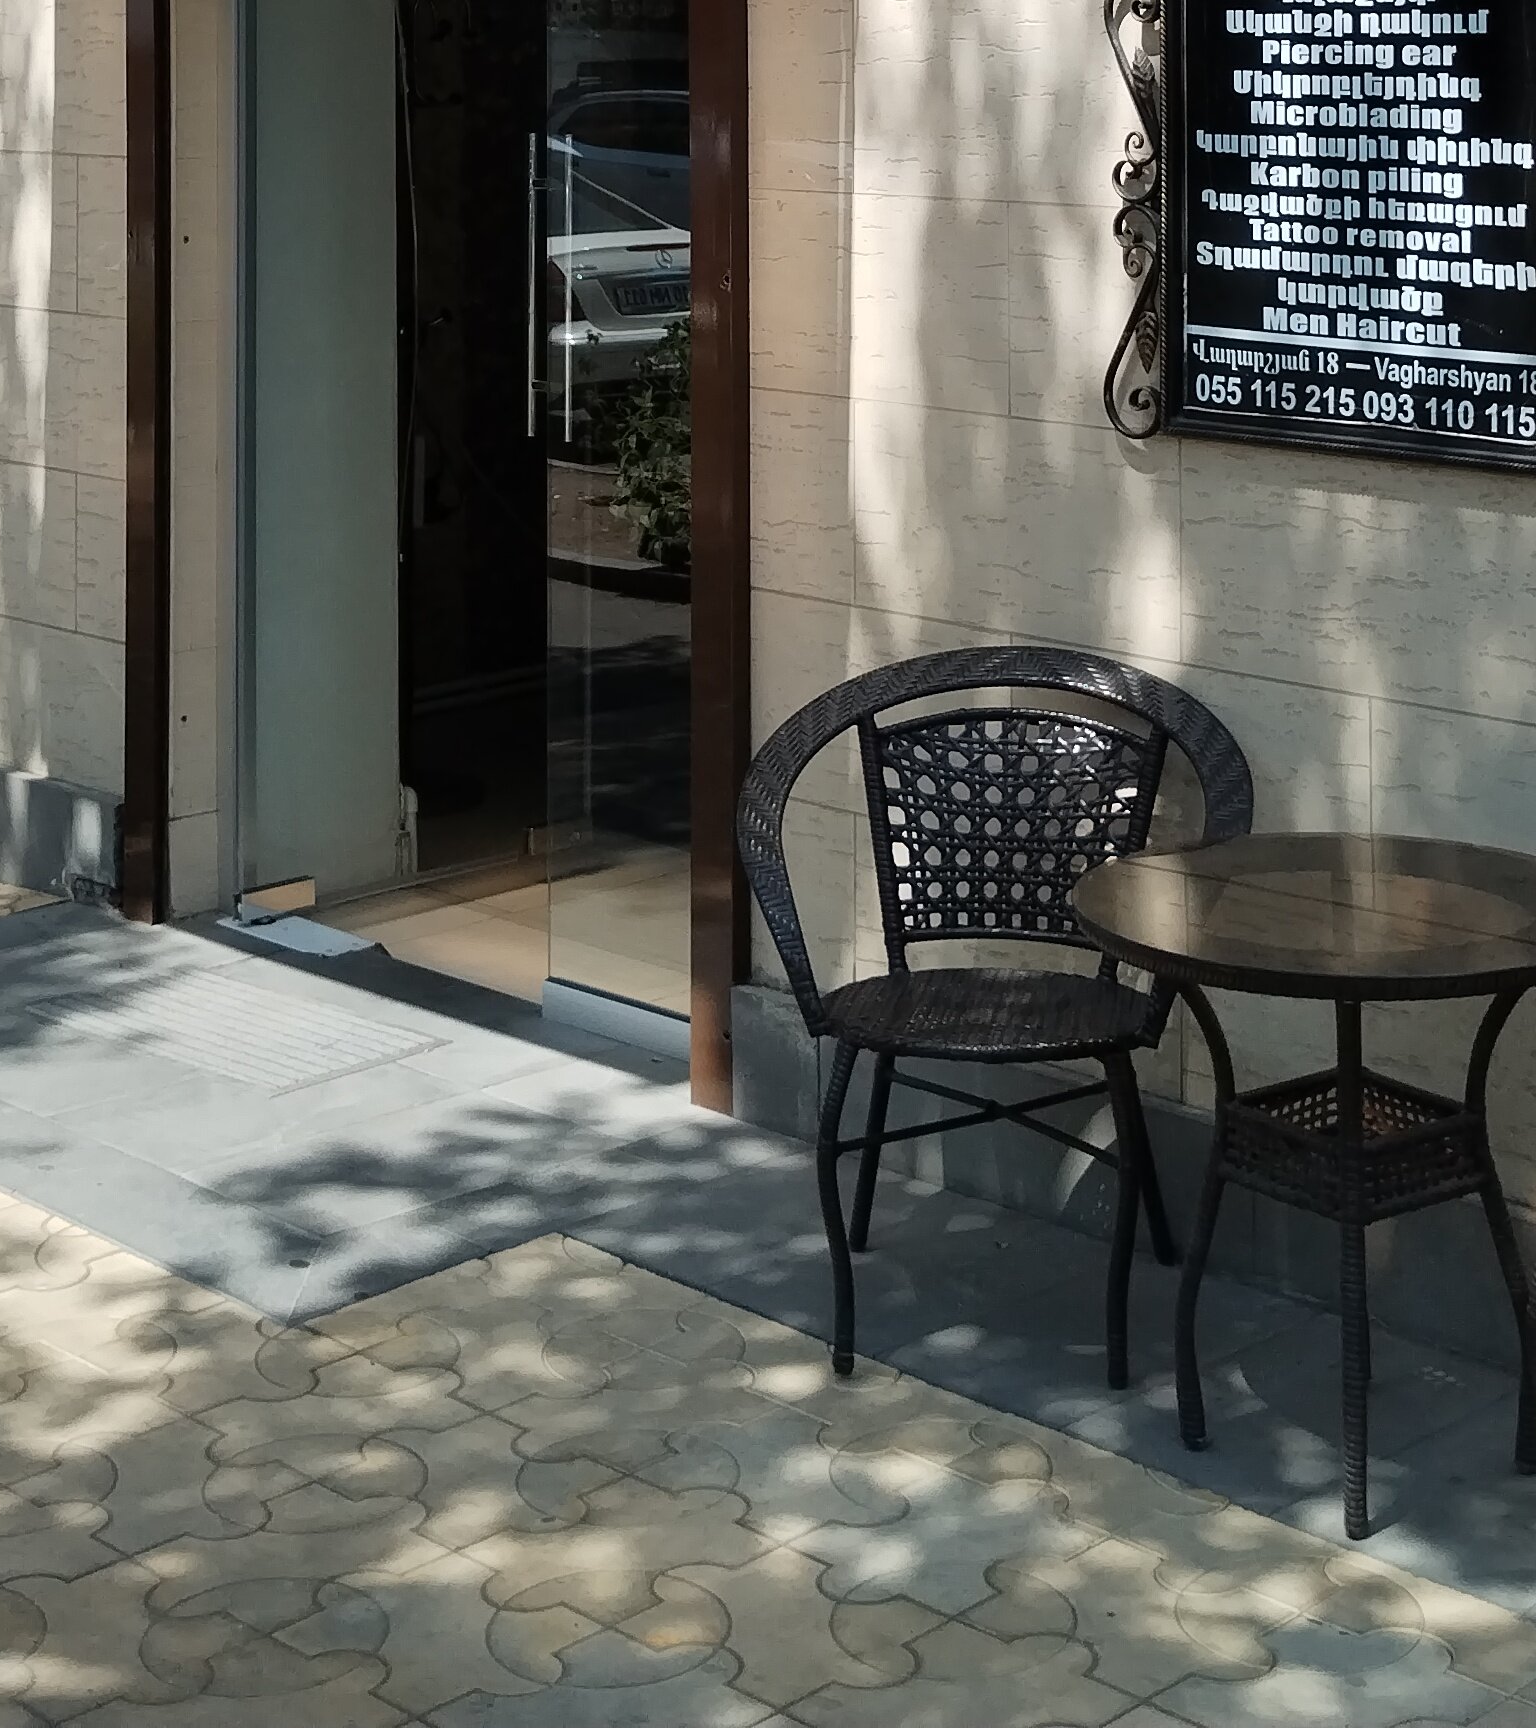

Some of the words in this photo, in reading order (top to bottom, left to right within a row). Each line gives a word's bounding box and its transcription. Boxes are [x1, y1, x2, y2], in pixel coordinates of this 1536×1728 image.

[1226, 9, 1353, 37] Ականջի
[1360, 9, 1490, 37] դակում
[1262, 39, 1395, 69] Piercing
[1401, 44, 1457, 67] ear
[1233, 70, 1482, 102] Միկրոբլեյդինգ
[1250, 100, 1463, 135] Microblading
[1196, 129, 1399, 162] Կարբոնային
[1407, 135, 1535, 169] փիլինգ
[1250, 161, 1360, 190] Karbon
[1368, 167, 1464, 199] piling
[1201, 188, 1361, 221] Դաջվածքի
[1368, 197, 1528, 228] հեռացում
[1249, 219, 1339, 245] Tattoo
[1346, 225, 1472, 254] removal
[1196, 241, 1389, 278] Տղամարդու
[1396, 255, 1536, 291] մազերի
[1263, 306, 1329, 335] Men
[1336, 314, 1461, 347] Haircut
[1192, 338, 1310, 375] Վաղարշյան
[1317, 351, 1339, 375] 18
[1374, 356, 1512, 393] Vagharshyan
[1196, 373, 1242, 406] 055
[1250, 379, 1296, 410] 115
[1305, 384, 1356, 417] 215
[1363, 391, 1415, 424] 093
[1425, 397, 1475, 431] 110
[1485, 403, 1536, 438] 115
